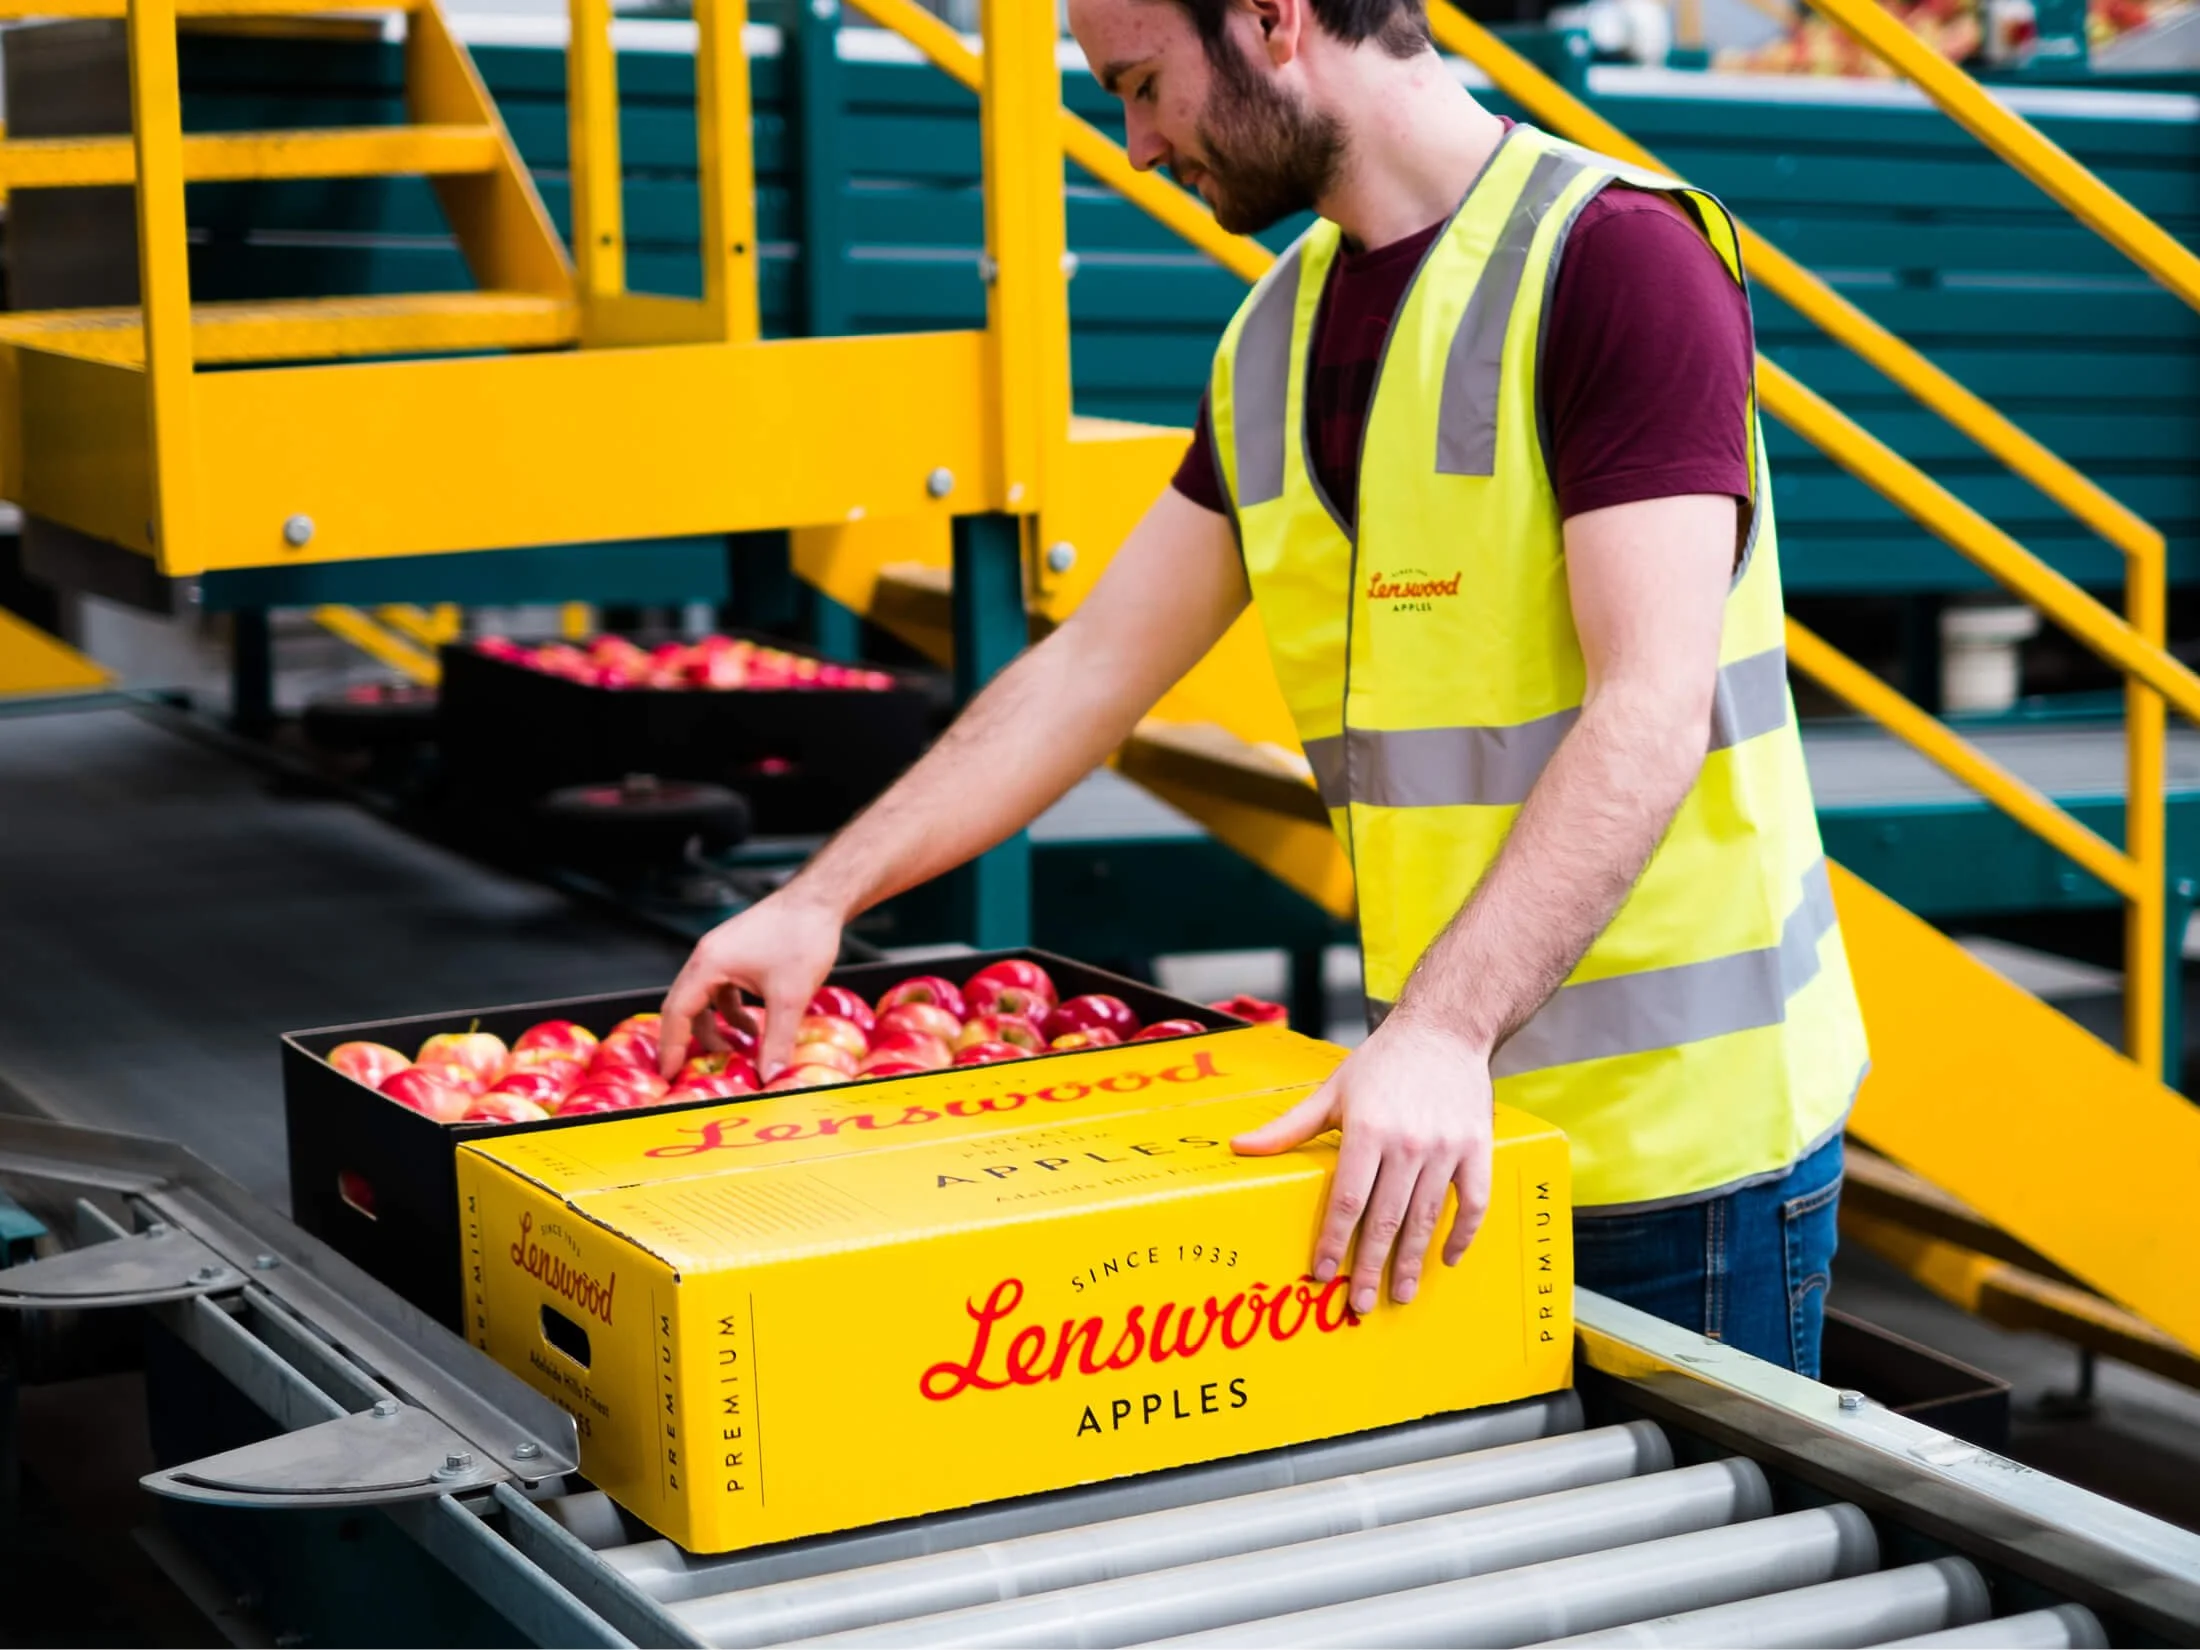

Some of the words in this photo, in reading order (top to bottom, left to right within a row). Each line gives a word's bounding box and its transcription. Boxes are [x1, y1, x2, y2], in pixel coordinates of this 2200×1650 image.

[1367, 571, 1462, 599] Lenswood
[1392, 602, 1432, 612] APPLES
[643, 1051, 1233, 1158] Lenswood
[937, 1135, 1220, 1189] APPLES
[510, 1211, 616, 1327] Lenswood
[1071, 1247, 1160, 1293] SINCE
[1178, 1244, 1238, 1268] 1933
[1537, 1181, 1555, 1343] PREMIUM
[660, 1314, 679, 1491] PREMIUM
[717, 1315, 745, 1493] PREMIUM
[1076, 1377, 1249, 1437] APPLES
